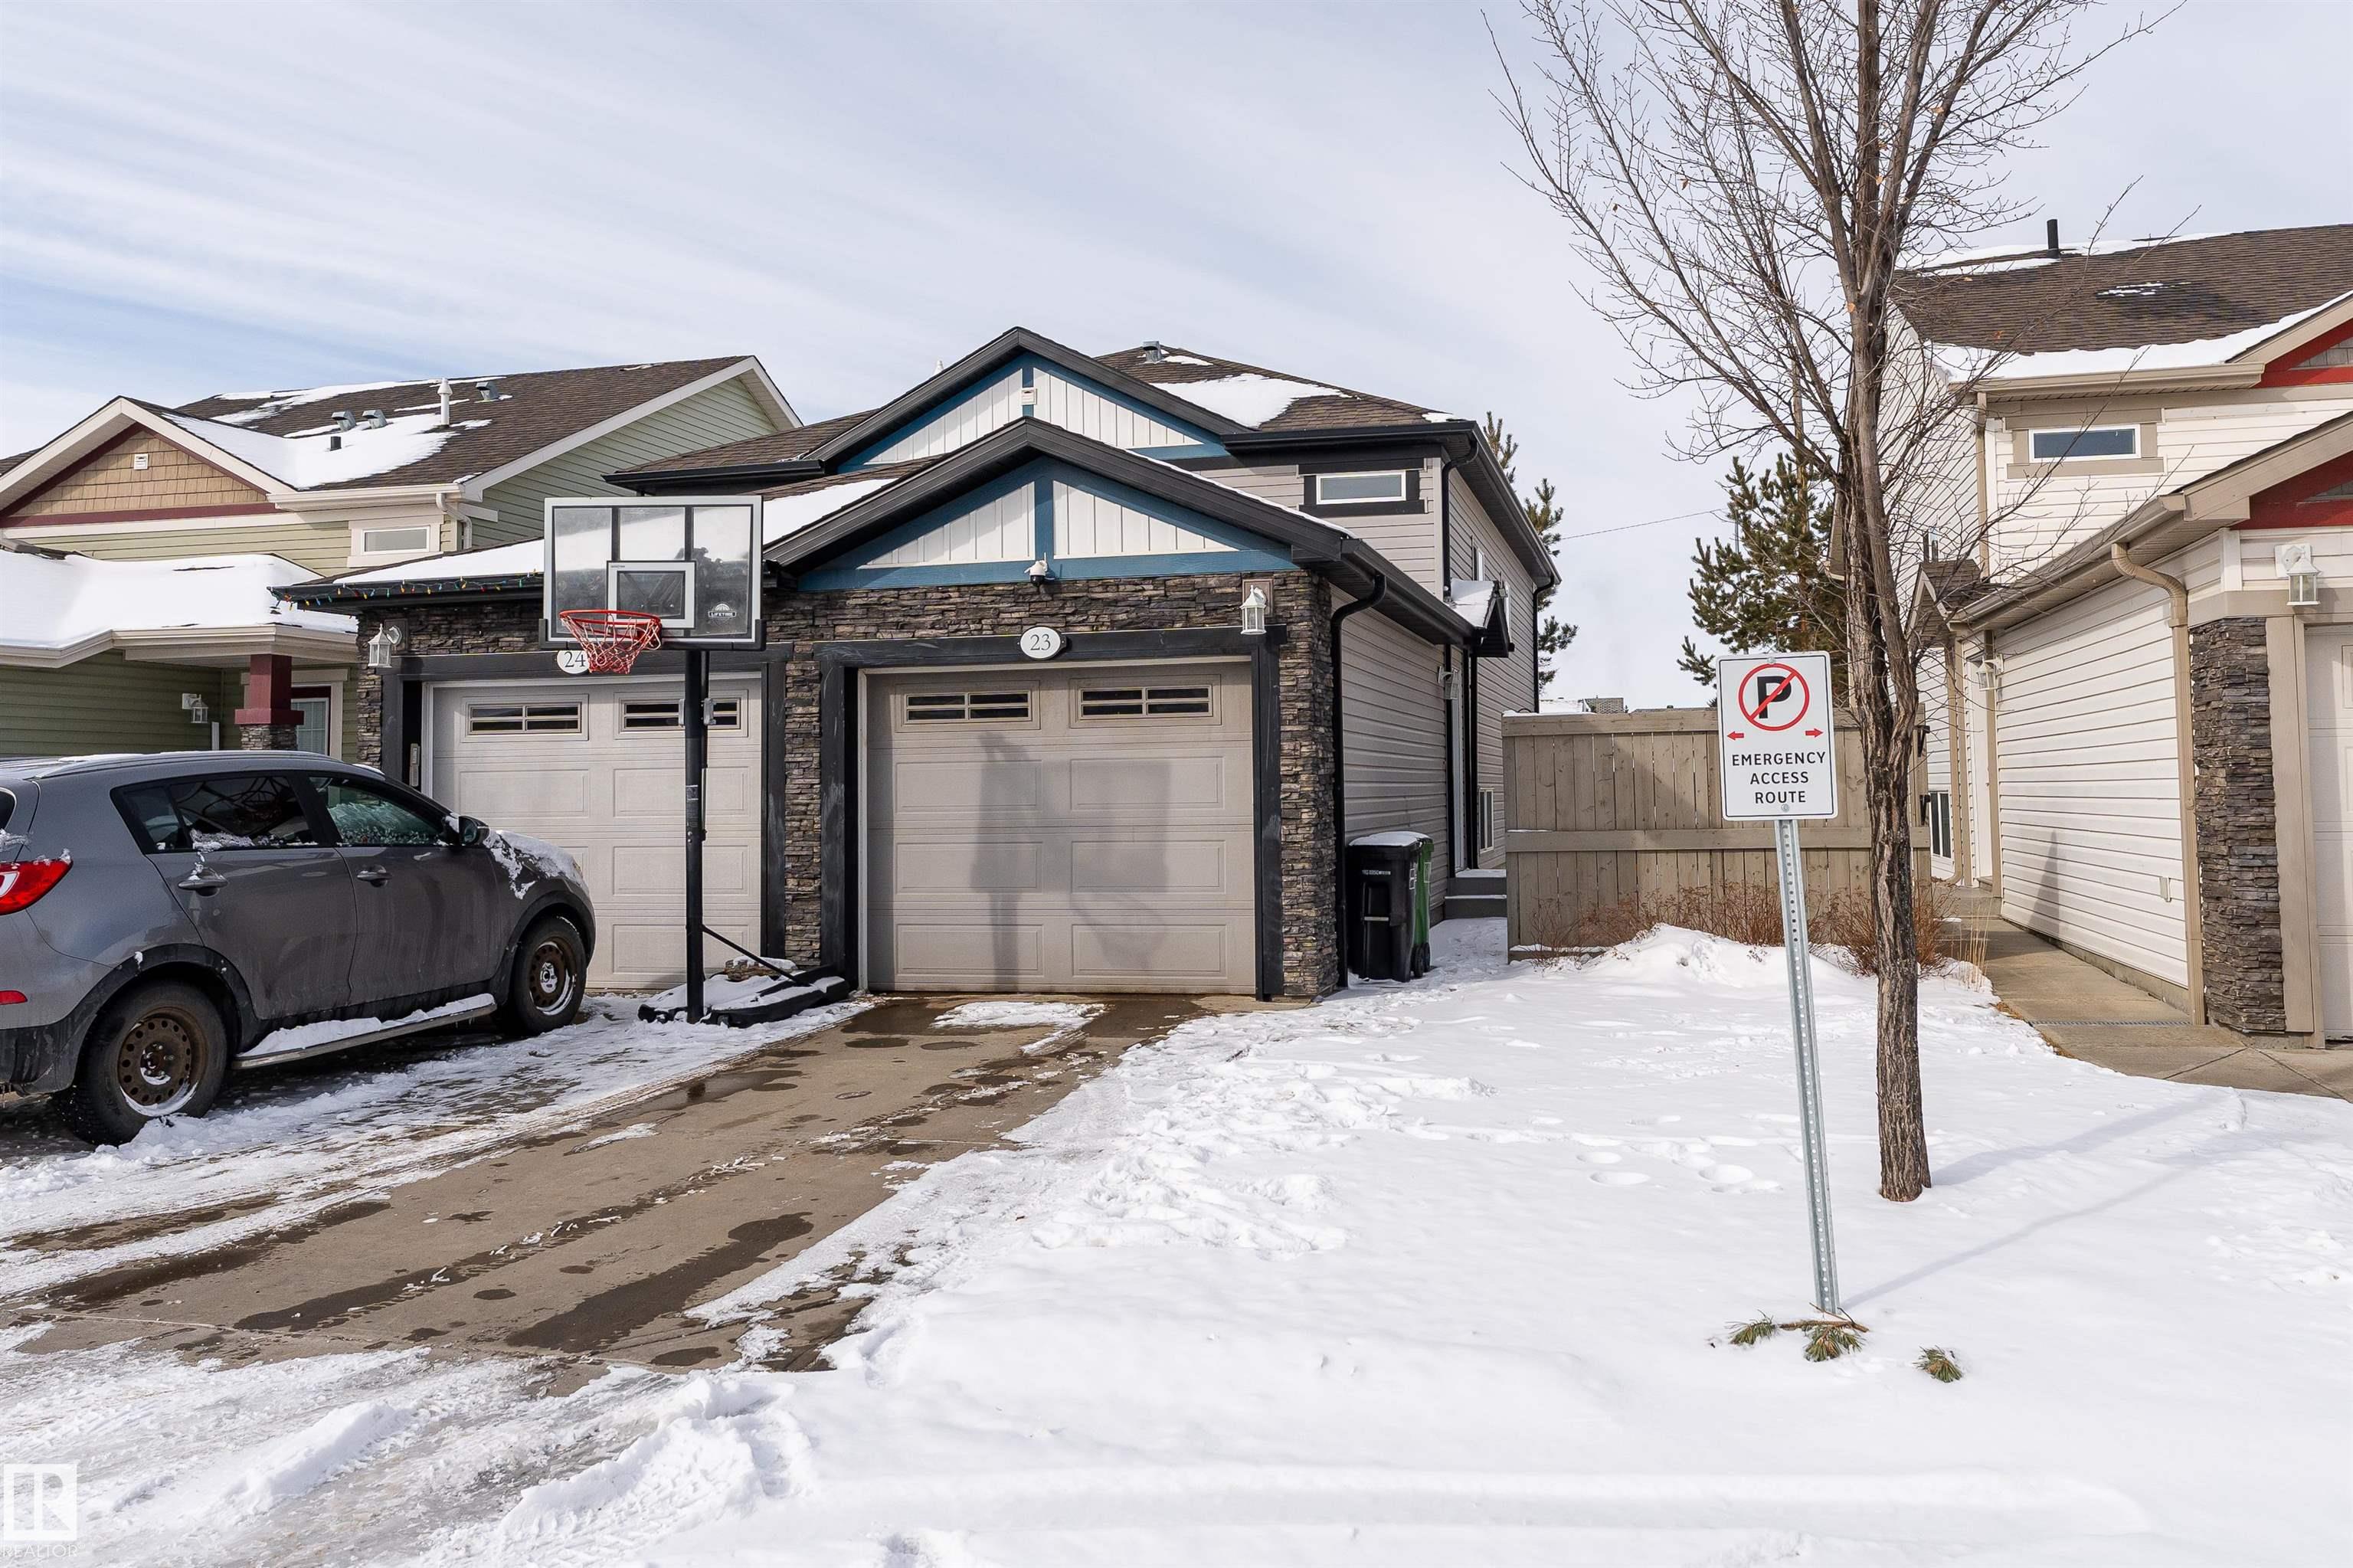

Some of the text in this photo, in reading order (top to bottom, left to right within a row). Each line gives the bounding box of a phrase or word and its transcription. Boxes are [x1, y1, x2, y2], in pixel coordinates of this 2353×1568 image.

[1030, 633, 1051, 650] 23
[564, 651, 586, 667] 24
[1757, 676, 1792, 719] P
[1732, 751, 1826, 766] EMERGENCY
[1750, 771, 1808, 784] ACCESS
[1756, 791, 1806, 804] ROUTE
